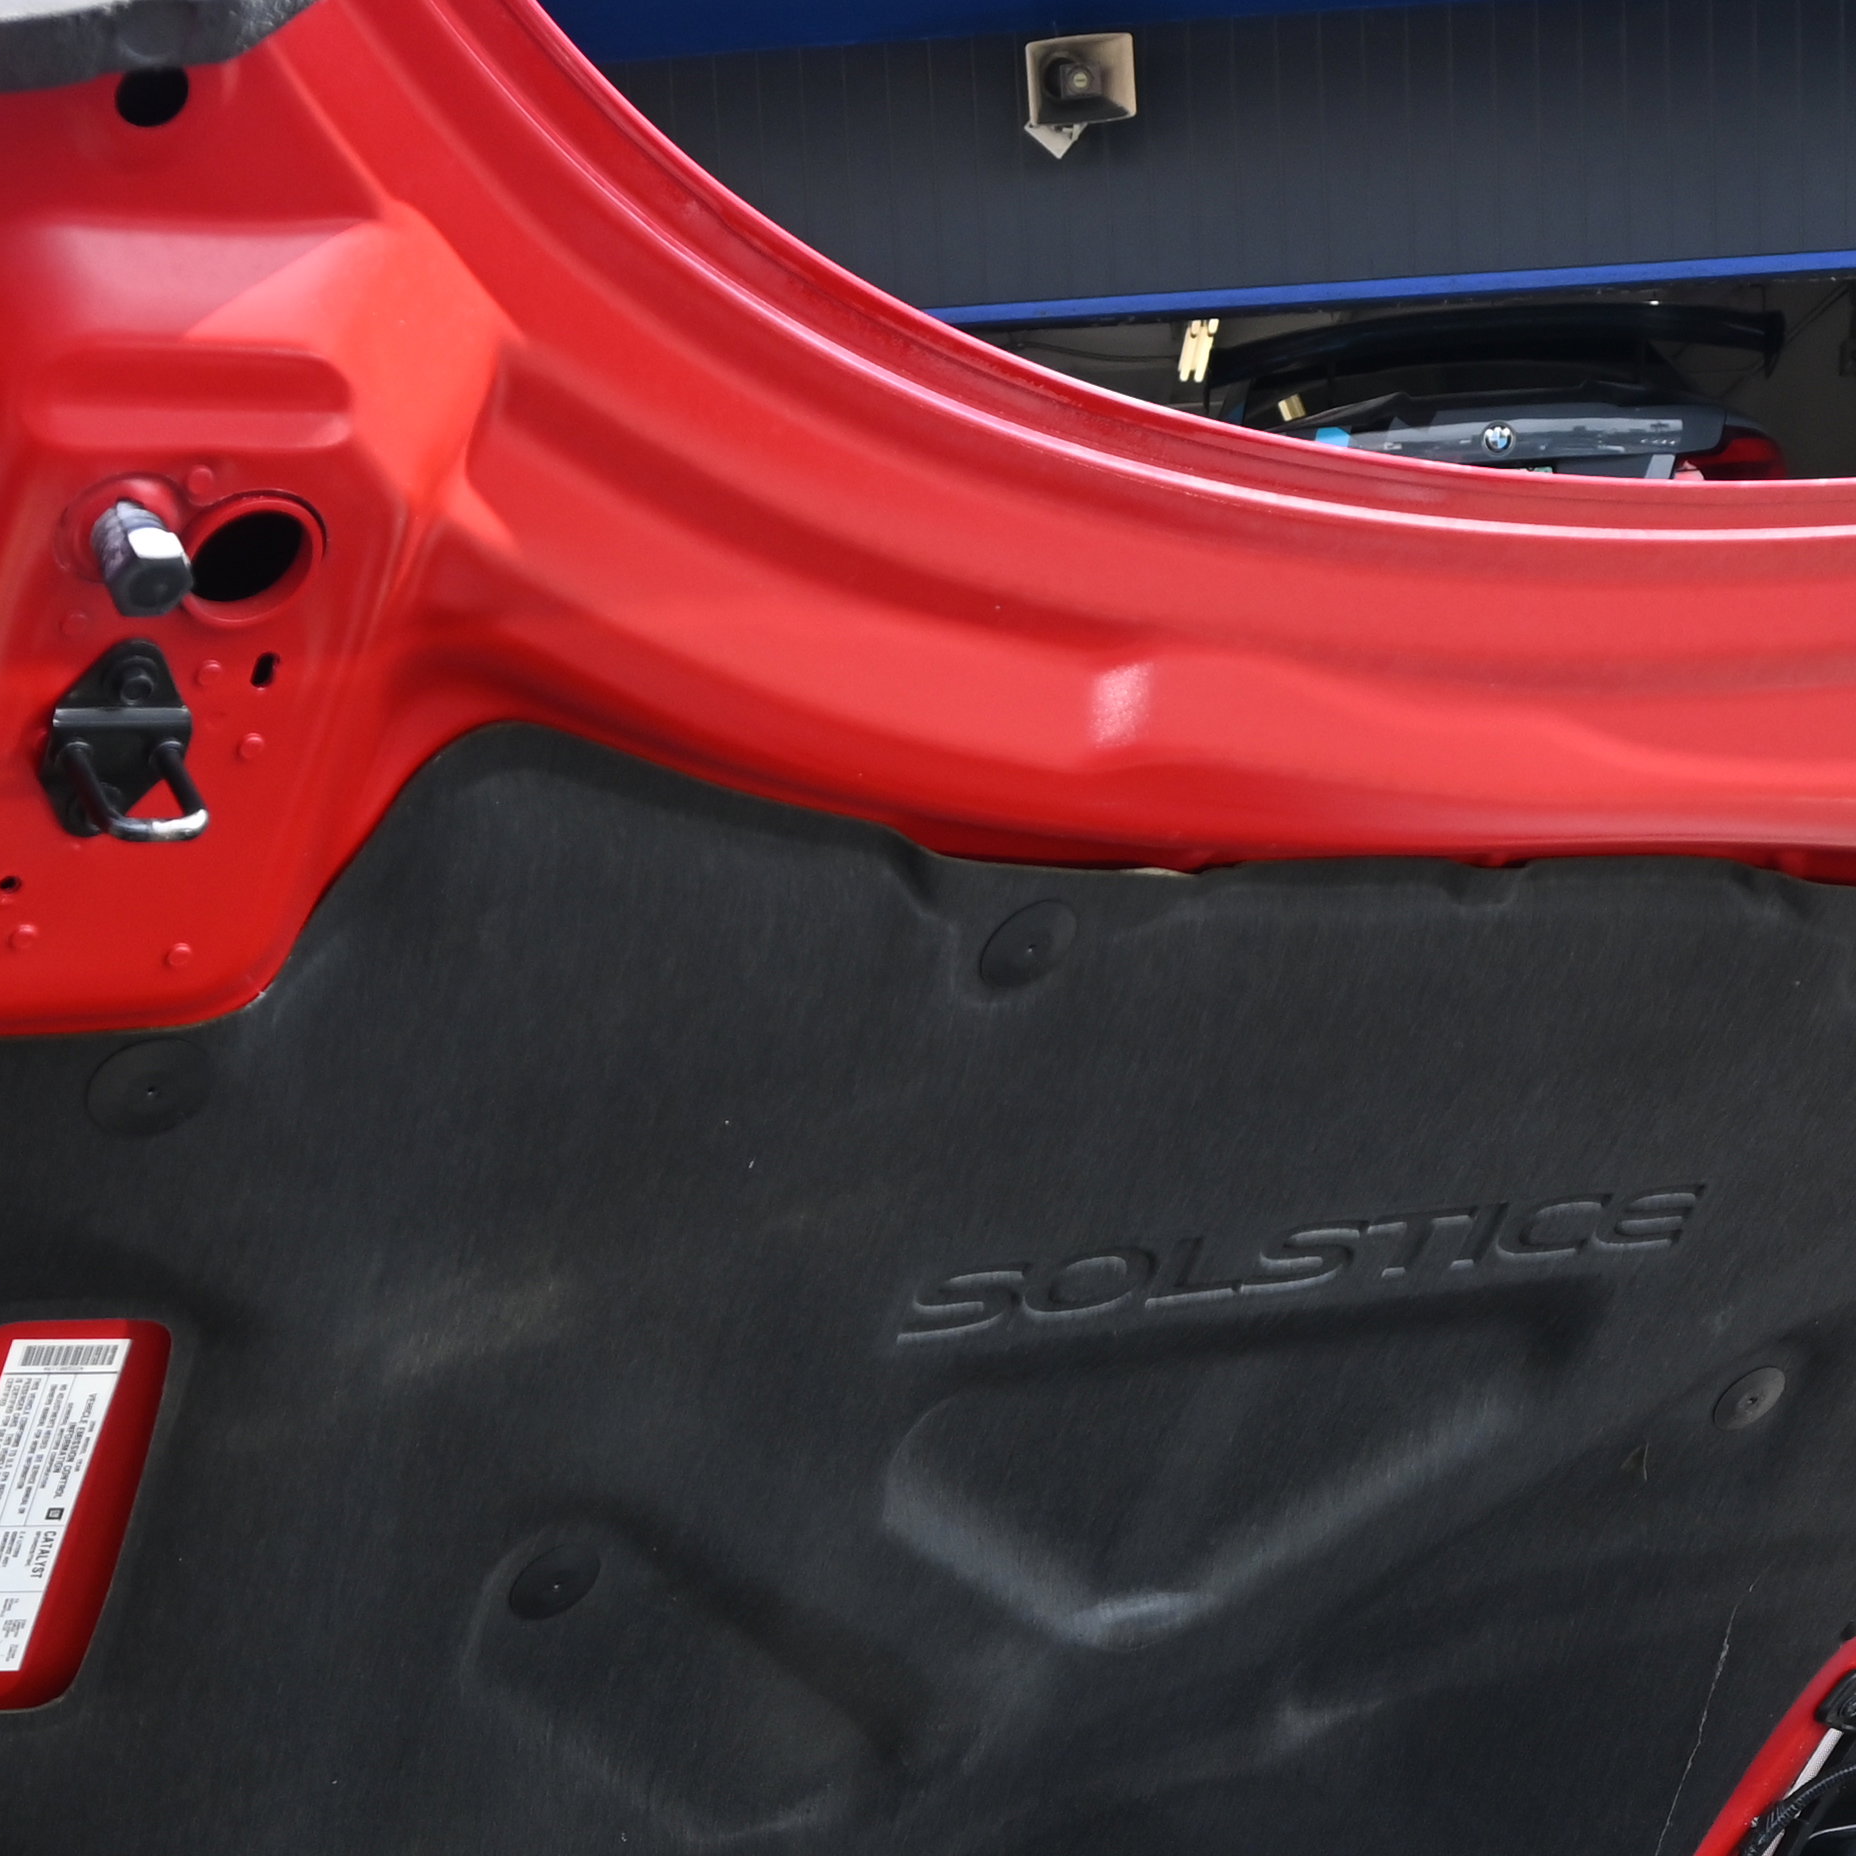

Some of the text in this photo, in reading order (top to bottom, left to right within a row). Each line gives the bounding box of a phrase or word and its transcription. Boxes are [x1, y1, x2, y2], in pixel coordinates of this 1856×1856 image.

[897, 1182, 1705, 1345] SOLSTICE
[53, 1422, 75, 1472] INFORMATION
[54, 1393, 95, 1498] VEHICLE EMISSION CONTROL
[30, 1531, 55, 1577] CATALYST
